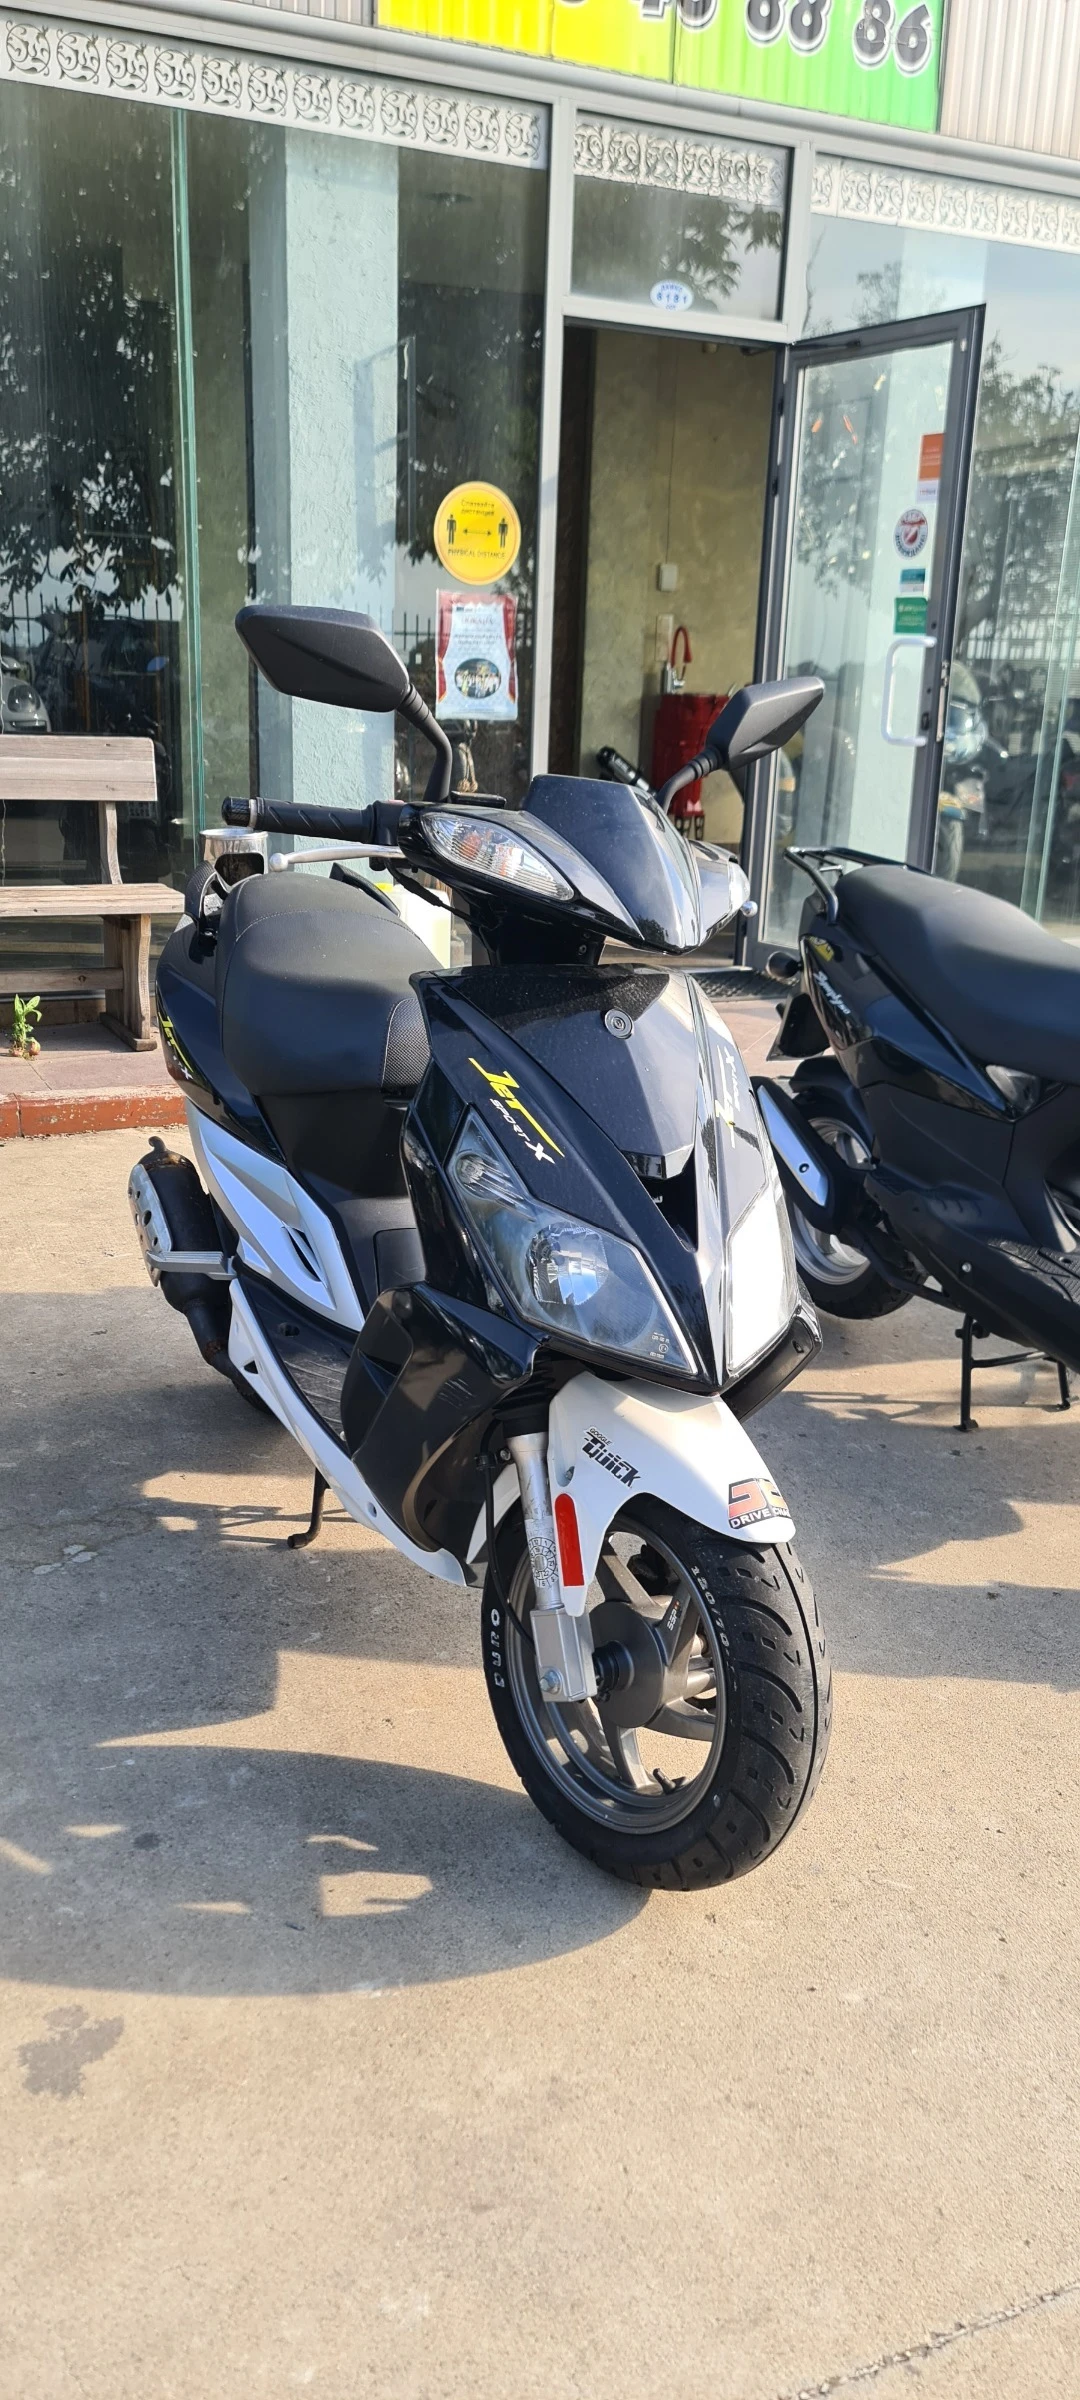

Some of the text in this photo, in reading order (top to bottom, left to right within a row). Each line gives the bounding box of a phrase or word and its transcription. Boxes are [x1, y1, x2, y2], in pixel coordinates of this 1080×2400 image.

[854, 0, 932, 74] 86
[448, 549, 505, 559] PHYSICAL DISTANCE
[731, 1508, 771, 1529] DRIVE
[491, 1608, 505, 1688] DURO
